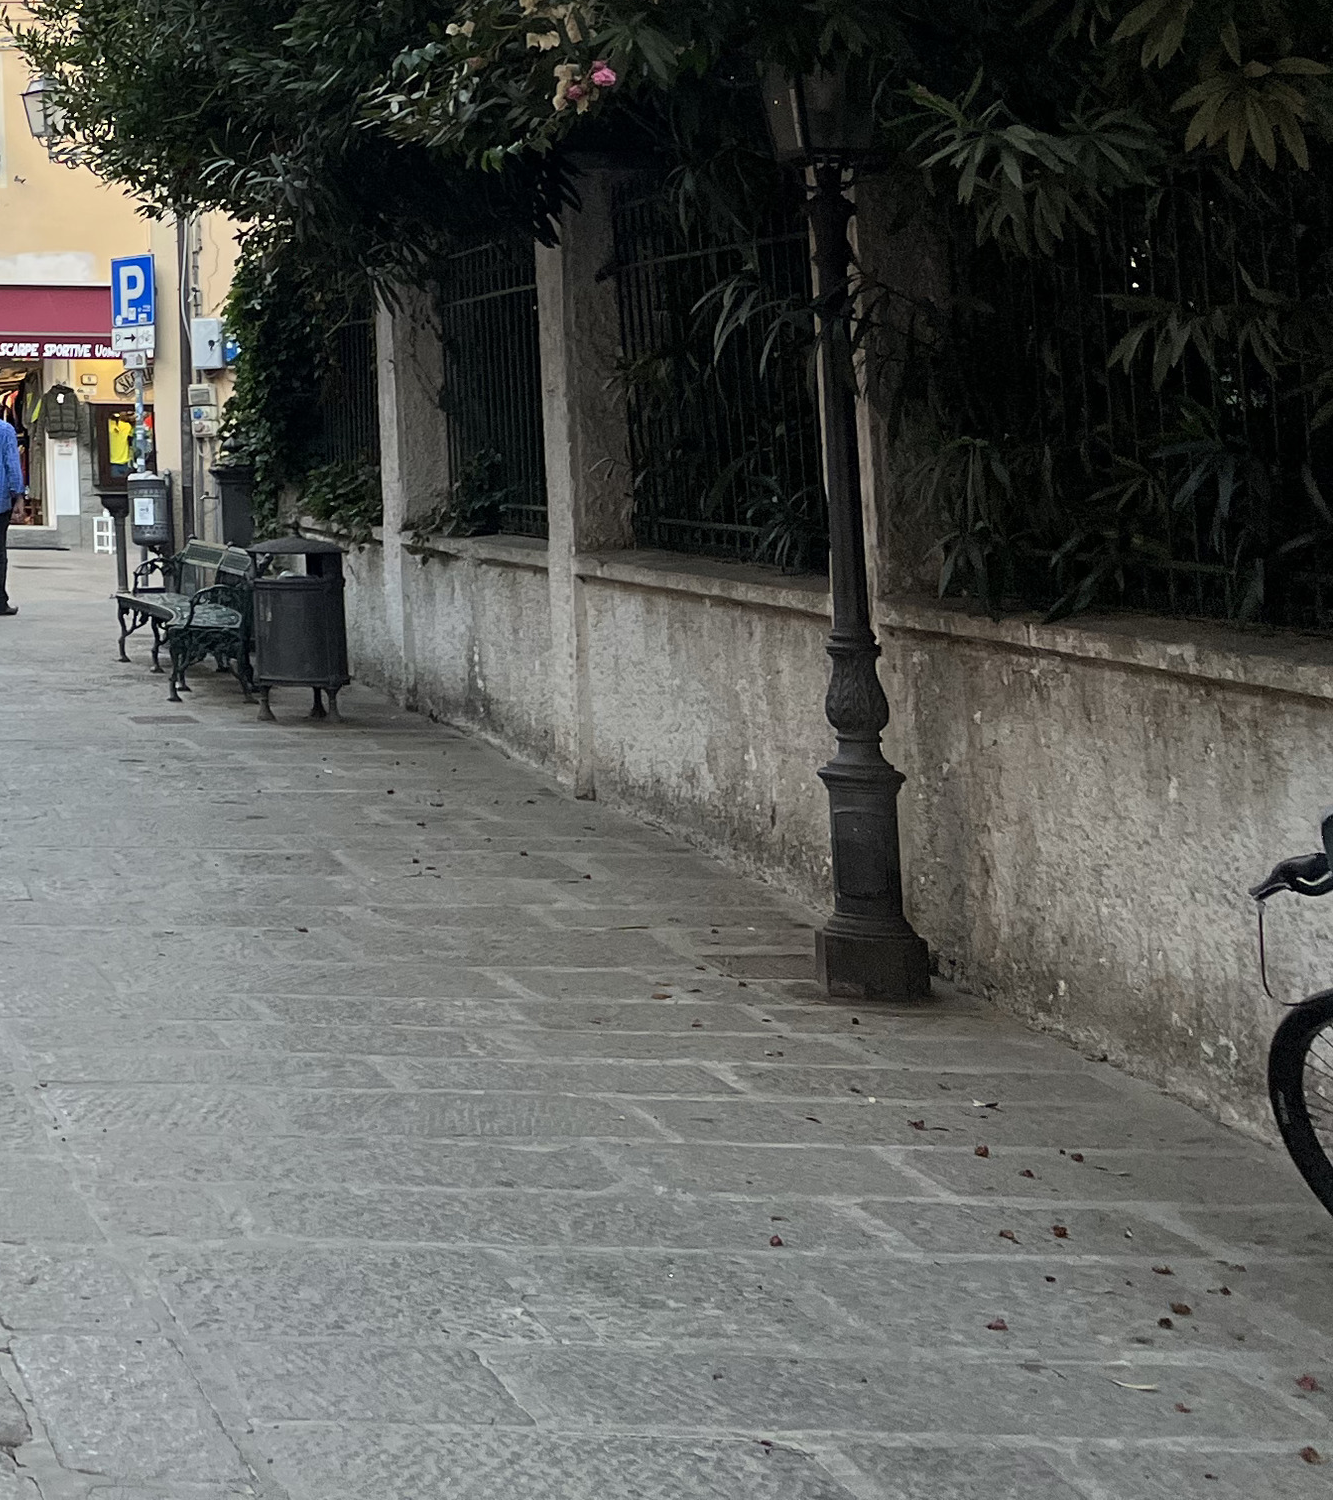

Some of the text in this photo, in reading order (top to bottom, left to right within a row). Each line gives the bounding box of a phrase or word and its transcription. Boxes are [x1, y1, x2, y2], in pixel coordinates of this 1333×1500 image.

[119, 265, 145, 318] P
[0, 342, 39, 357] SCARPE
[42, 343, 92, 357] SPORTIVE
